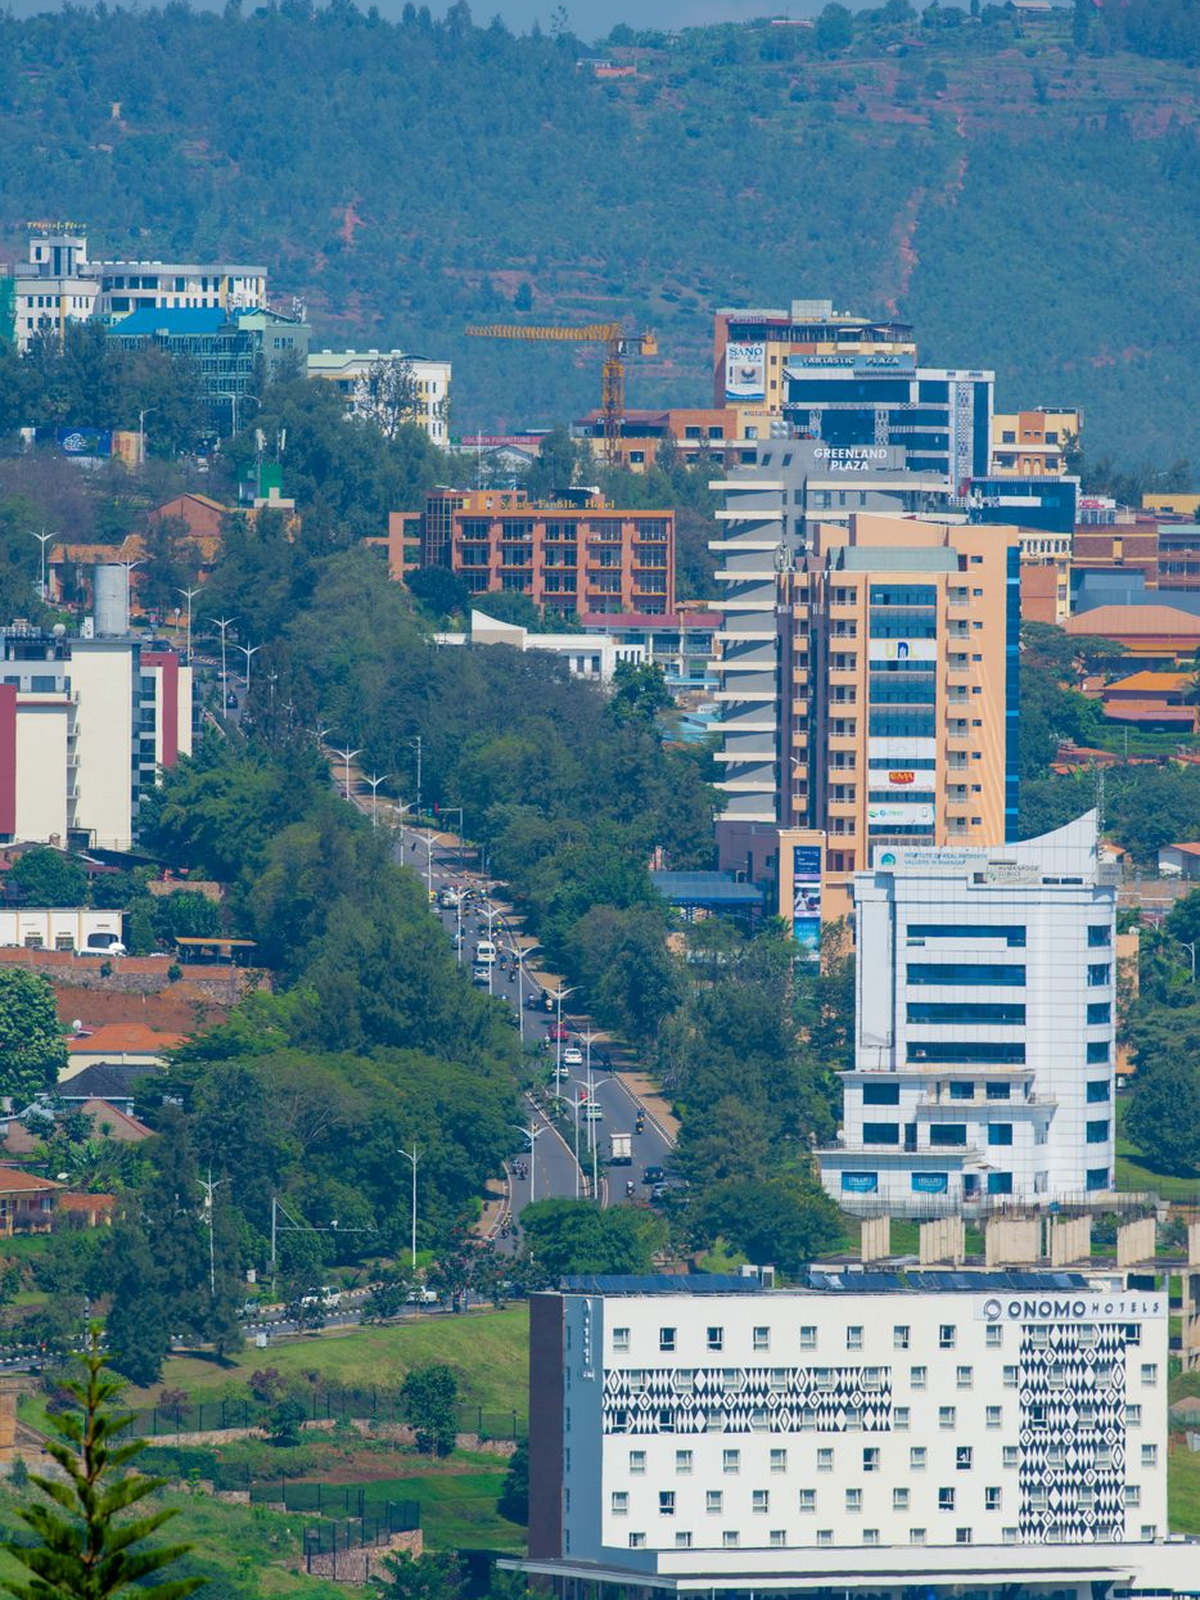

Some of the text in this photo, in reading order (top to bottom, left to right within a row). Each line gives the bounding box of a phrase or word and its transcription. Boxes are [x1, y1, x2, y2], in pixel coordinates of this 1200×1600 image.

[729, 346, 763, 357] SANO
[867, 356, 900, 364] PLAZA
[813, 448, 888, 459] GREENLAND
[830, 460, 869, 472] PLAZA
[585, 499, 615, 509] Hotel
[1008, 1301, 1160, 1317] ONOMO HOTELS
